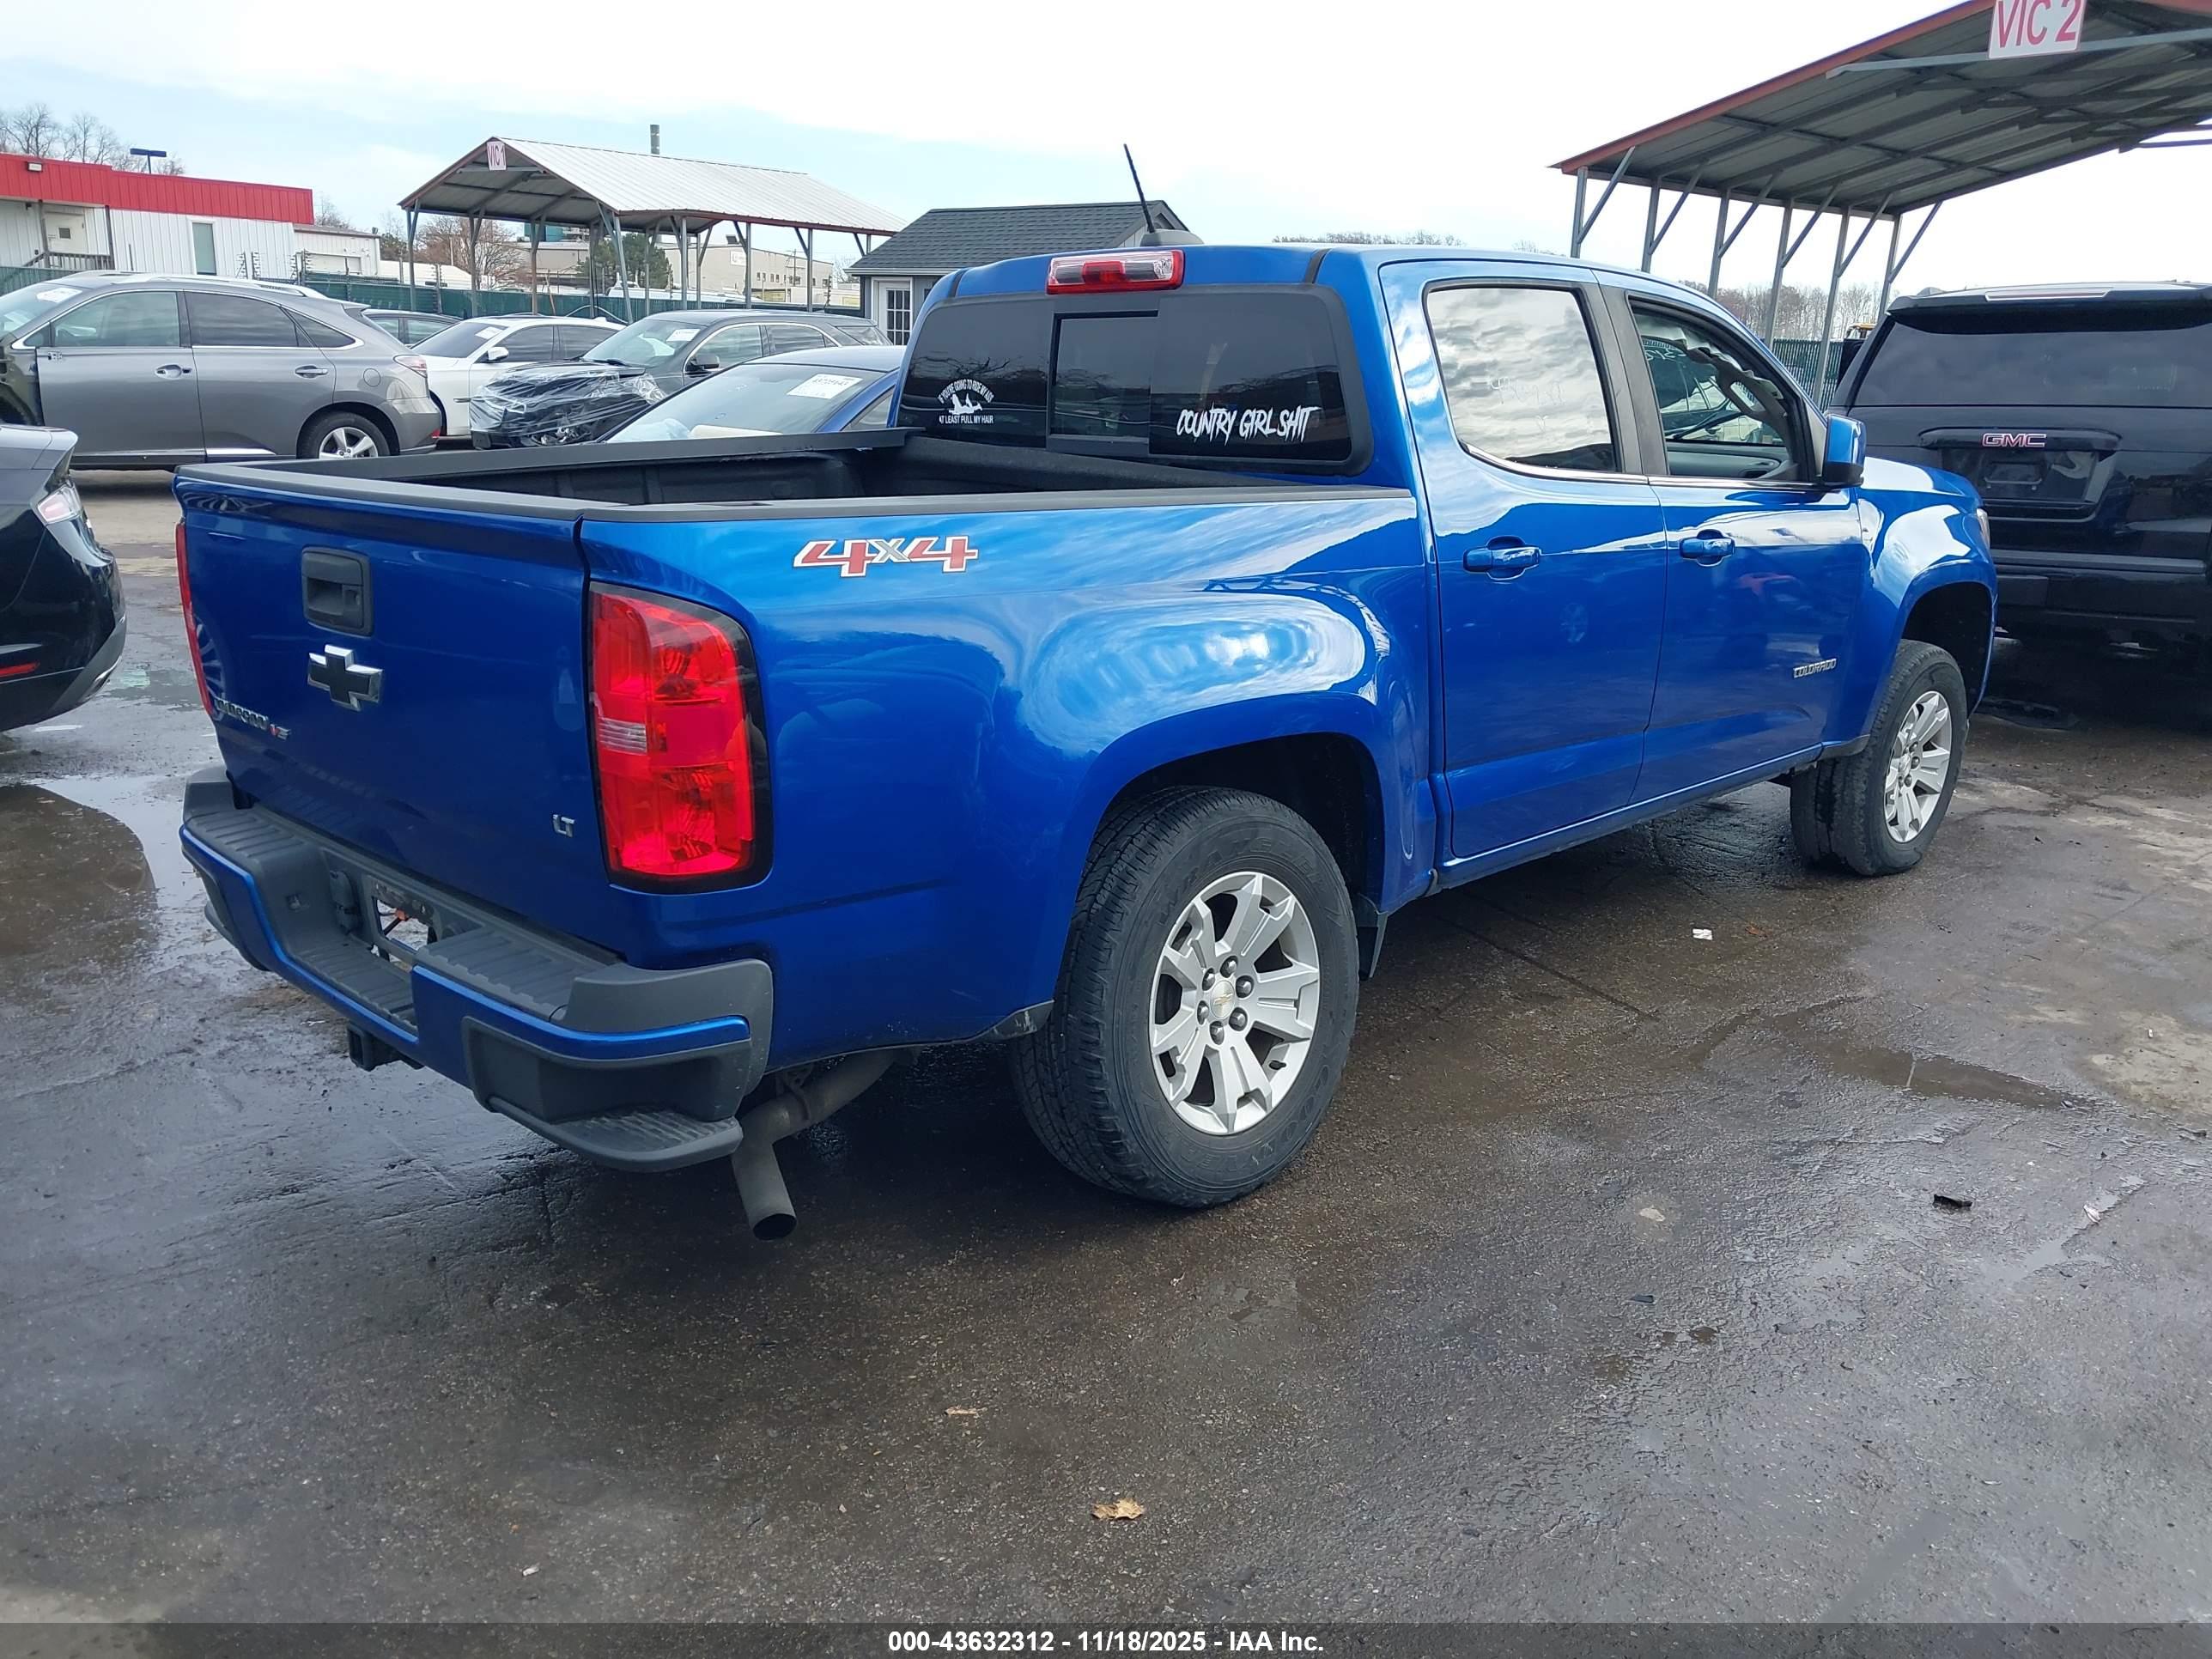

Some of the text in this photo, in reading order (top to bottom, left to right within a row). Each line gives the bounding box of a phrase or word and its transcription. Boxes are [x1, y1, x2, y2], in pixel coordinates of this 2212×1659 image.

[1997, 0, 2081, 48] VIC 2
[488, 145, 500, 167] VIC
[954, 379, 967, 392] GOING
[972, 380, 982, 393] RIDE
[980, 385, 988, 397] MY
[984, 390, 994, 403] ASS
[945, 415, 960, 423] LEAST
[961, 415, 972, 423] PULL
[974, 415, 981, 423] MY
[981, 415, 994, 423] HAIR
[1176, 400, 1323, 447] COUNTRY GIRL SHIT
[1982, 432, 2048, 447] GMC
[1792, 658, 1837, 678] COLORADO
[552, 814, 575, 838] LT
